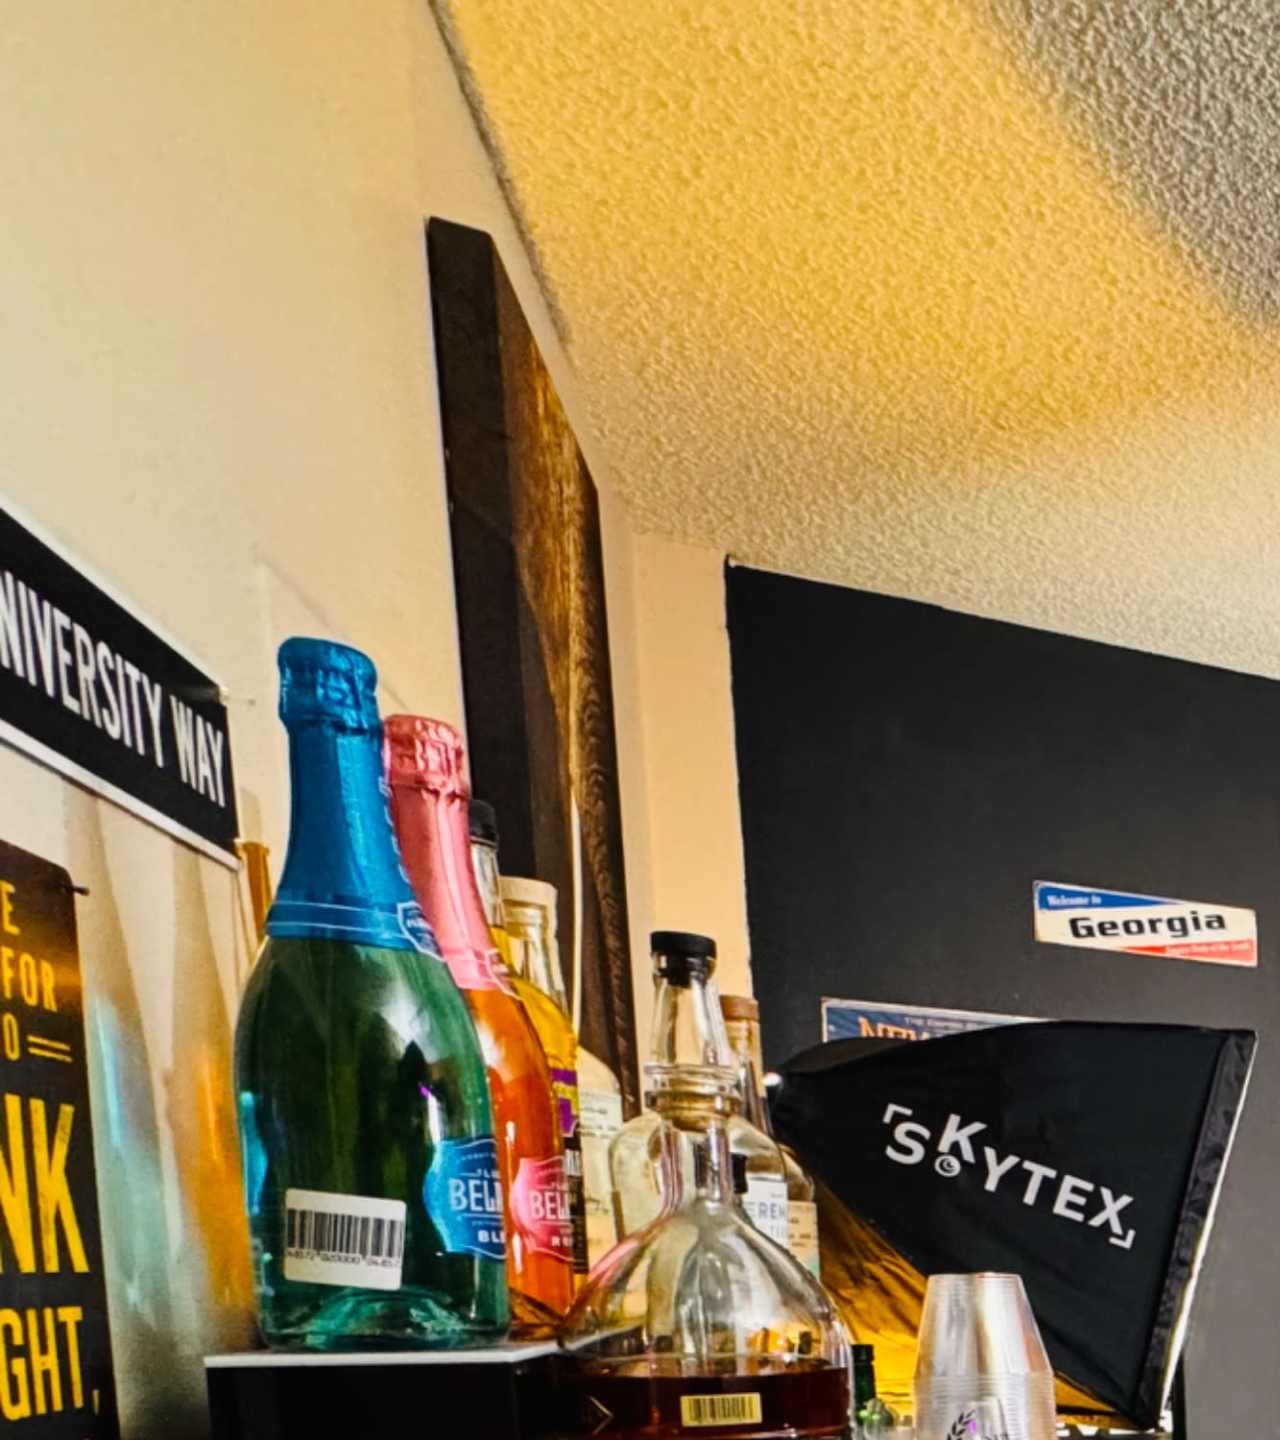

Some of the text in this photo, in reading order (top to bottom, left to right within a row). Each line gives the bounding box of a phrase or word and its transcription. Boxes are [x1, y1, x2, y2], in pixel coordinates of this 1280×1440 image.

[170, 694, 225, 807] WAY
[1069, 910, 1226, 938] Georgia
[1, 946, 57, 1012] FOR
[885, 1113, 1133, 1236] SKYTEX
